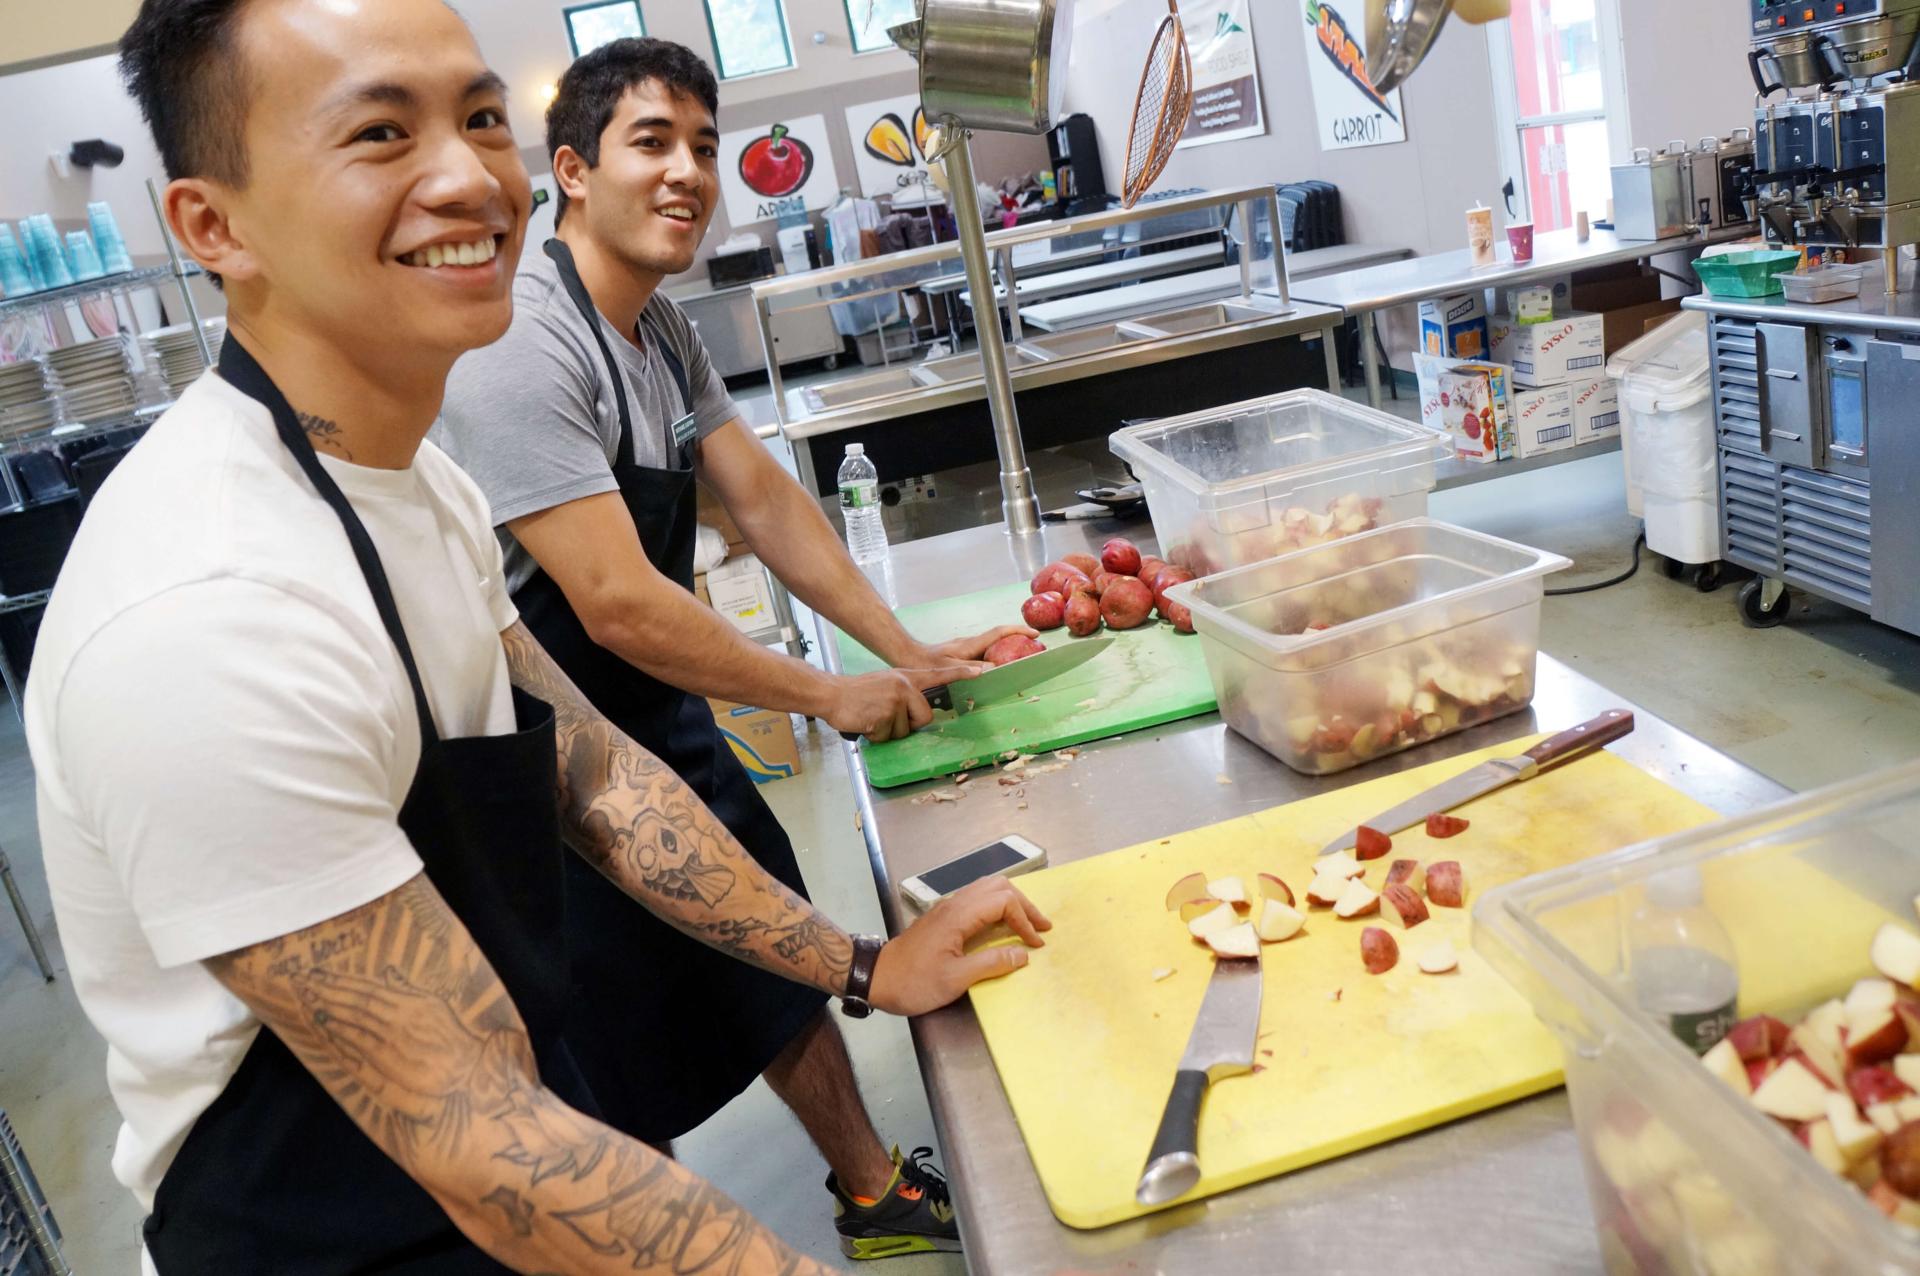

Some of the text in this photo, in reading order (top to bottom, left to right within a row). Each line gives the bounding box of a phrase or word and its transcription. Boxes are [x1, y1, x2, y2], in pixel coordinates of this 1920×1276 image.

[1333, 114, 1382, 144] CARROT
[1541, 324, 1573, 354] SYSCO
[1576, 383, 1599, 404] SYSCO
[1423, 399, 1441, 417] SYSC
[1522, 396, 1545, 418] SYSCO
